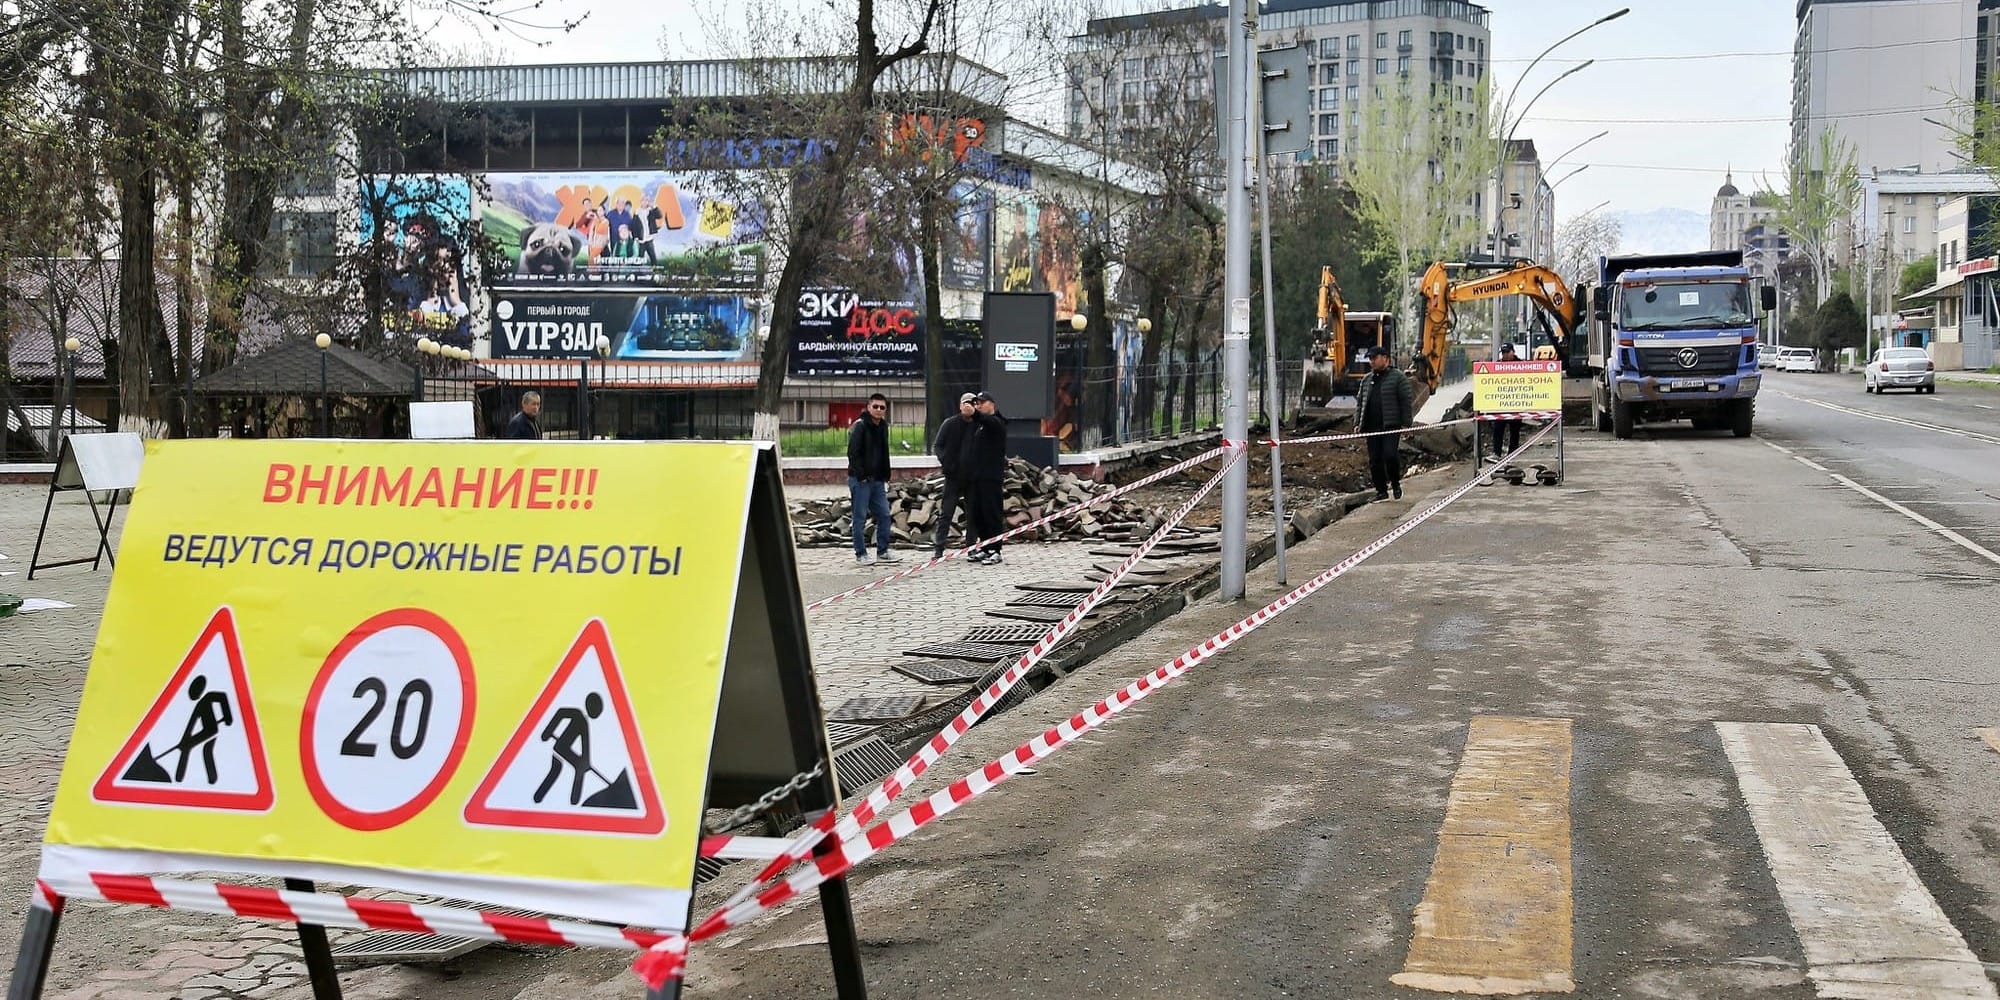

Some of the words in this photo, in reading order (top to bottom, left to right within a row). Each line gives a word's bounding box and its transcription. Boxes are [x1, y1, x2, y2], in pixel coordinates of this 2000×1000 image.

[1473, 281, 1509, 295] HYUNDAI
[527, 305, 556, 316] ПЕРВЫЙ
[557, 306, 563, 316] В
[564, 306, 590, 317] ГОРОДЕ
[798, 292, 859, 318] ЭКИ
[502, 322, 560, 351] VIP
[561, 322, 603, 351] ЗАЛ
[847, 309, 916, 338] ДОС
[798, 342, 835, 352] БАРДЫК
[836, 342, 918, 352] КИНОТЕАТРЛАРДА
[1494, 363, 1543, 371] ВНИМАНИЕ!!!
[1527, 377, 1553, 385] ЗОНА
[262, 463, 599, 511] ВНИМАНИЕ!!!
[163, 533, 313, 570] ВЕДУТСЯ
[318, 538, 522, 575] ДОРОЖНЫЕ
[532, 544, 683, 577] РАБОТЫ
[340, 676, 434, 759] 20
